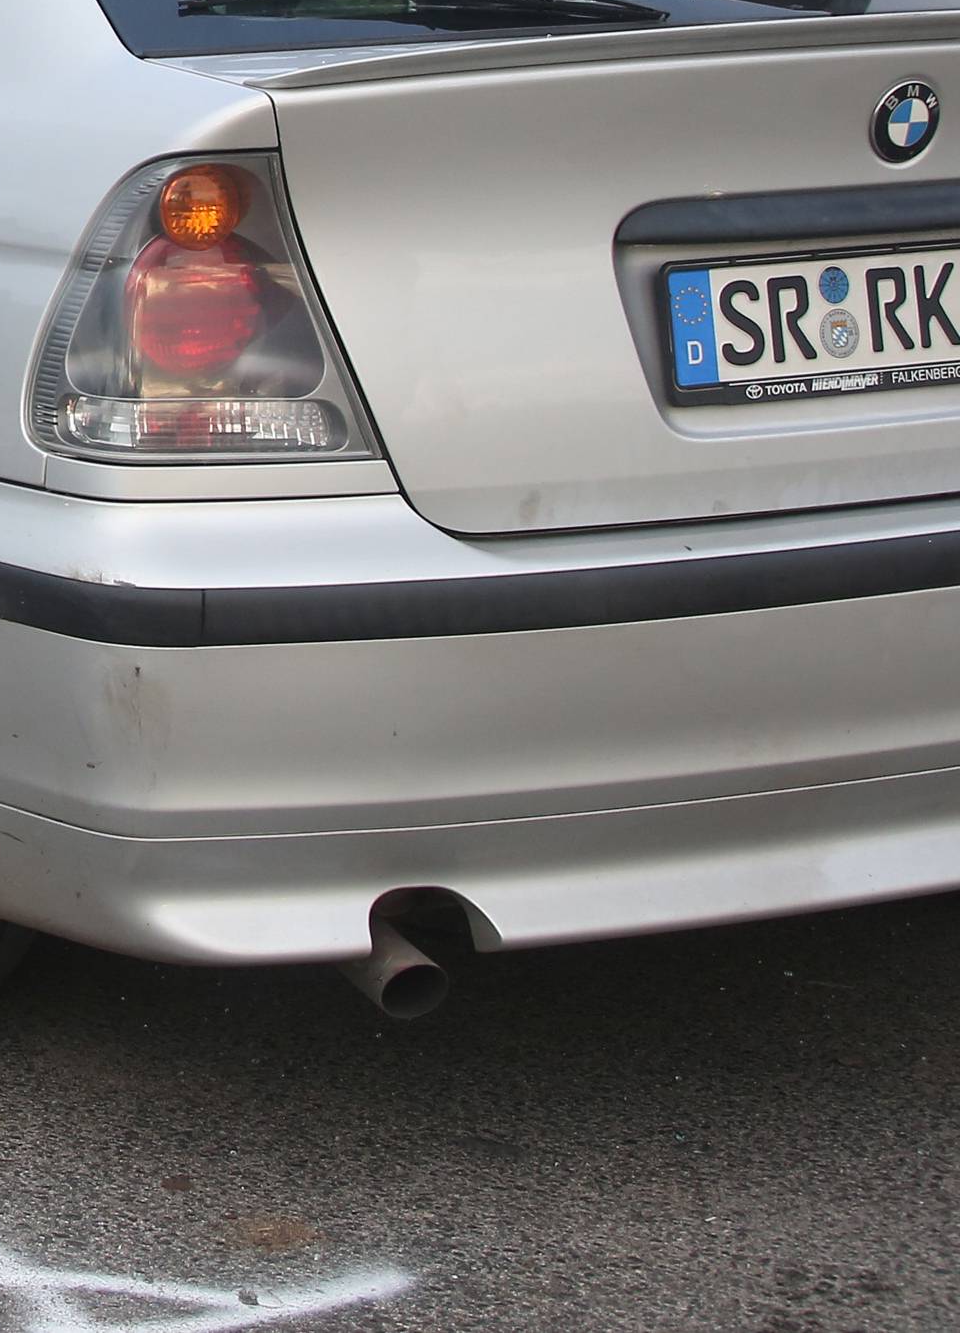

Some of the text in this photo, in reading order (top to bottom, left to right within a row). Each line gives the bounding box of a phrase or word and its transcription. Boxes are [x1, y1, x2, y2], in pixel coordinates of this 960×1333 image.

[884, 85, 938, 110] BMW
[719, 275, 818, 366] SR
[865, 262, 960, 353] RK
[687, 340, 703, 365] D
[765, 382, 808, 396] TOYOTA
[891, 366, 960, 384] FALKENBERG
